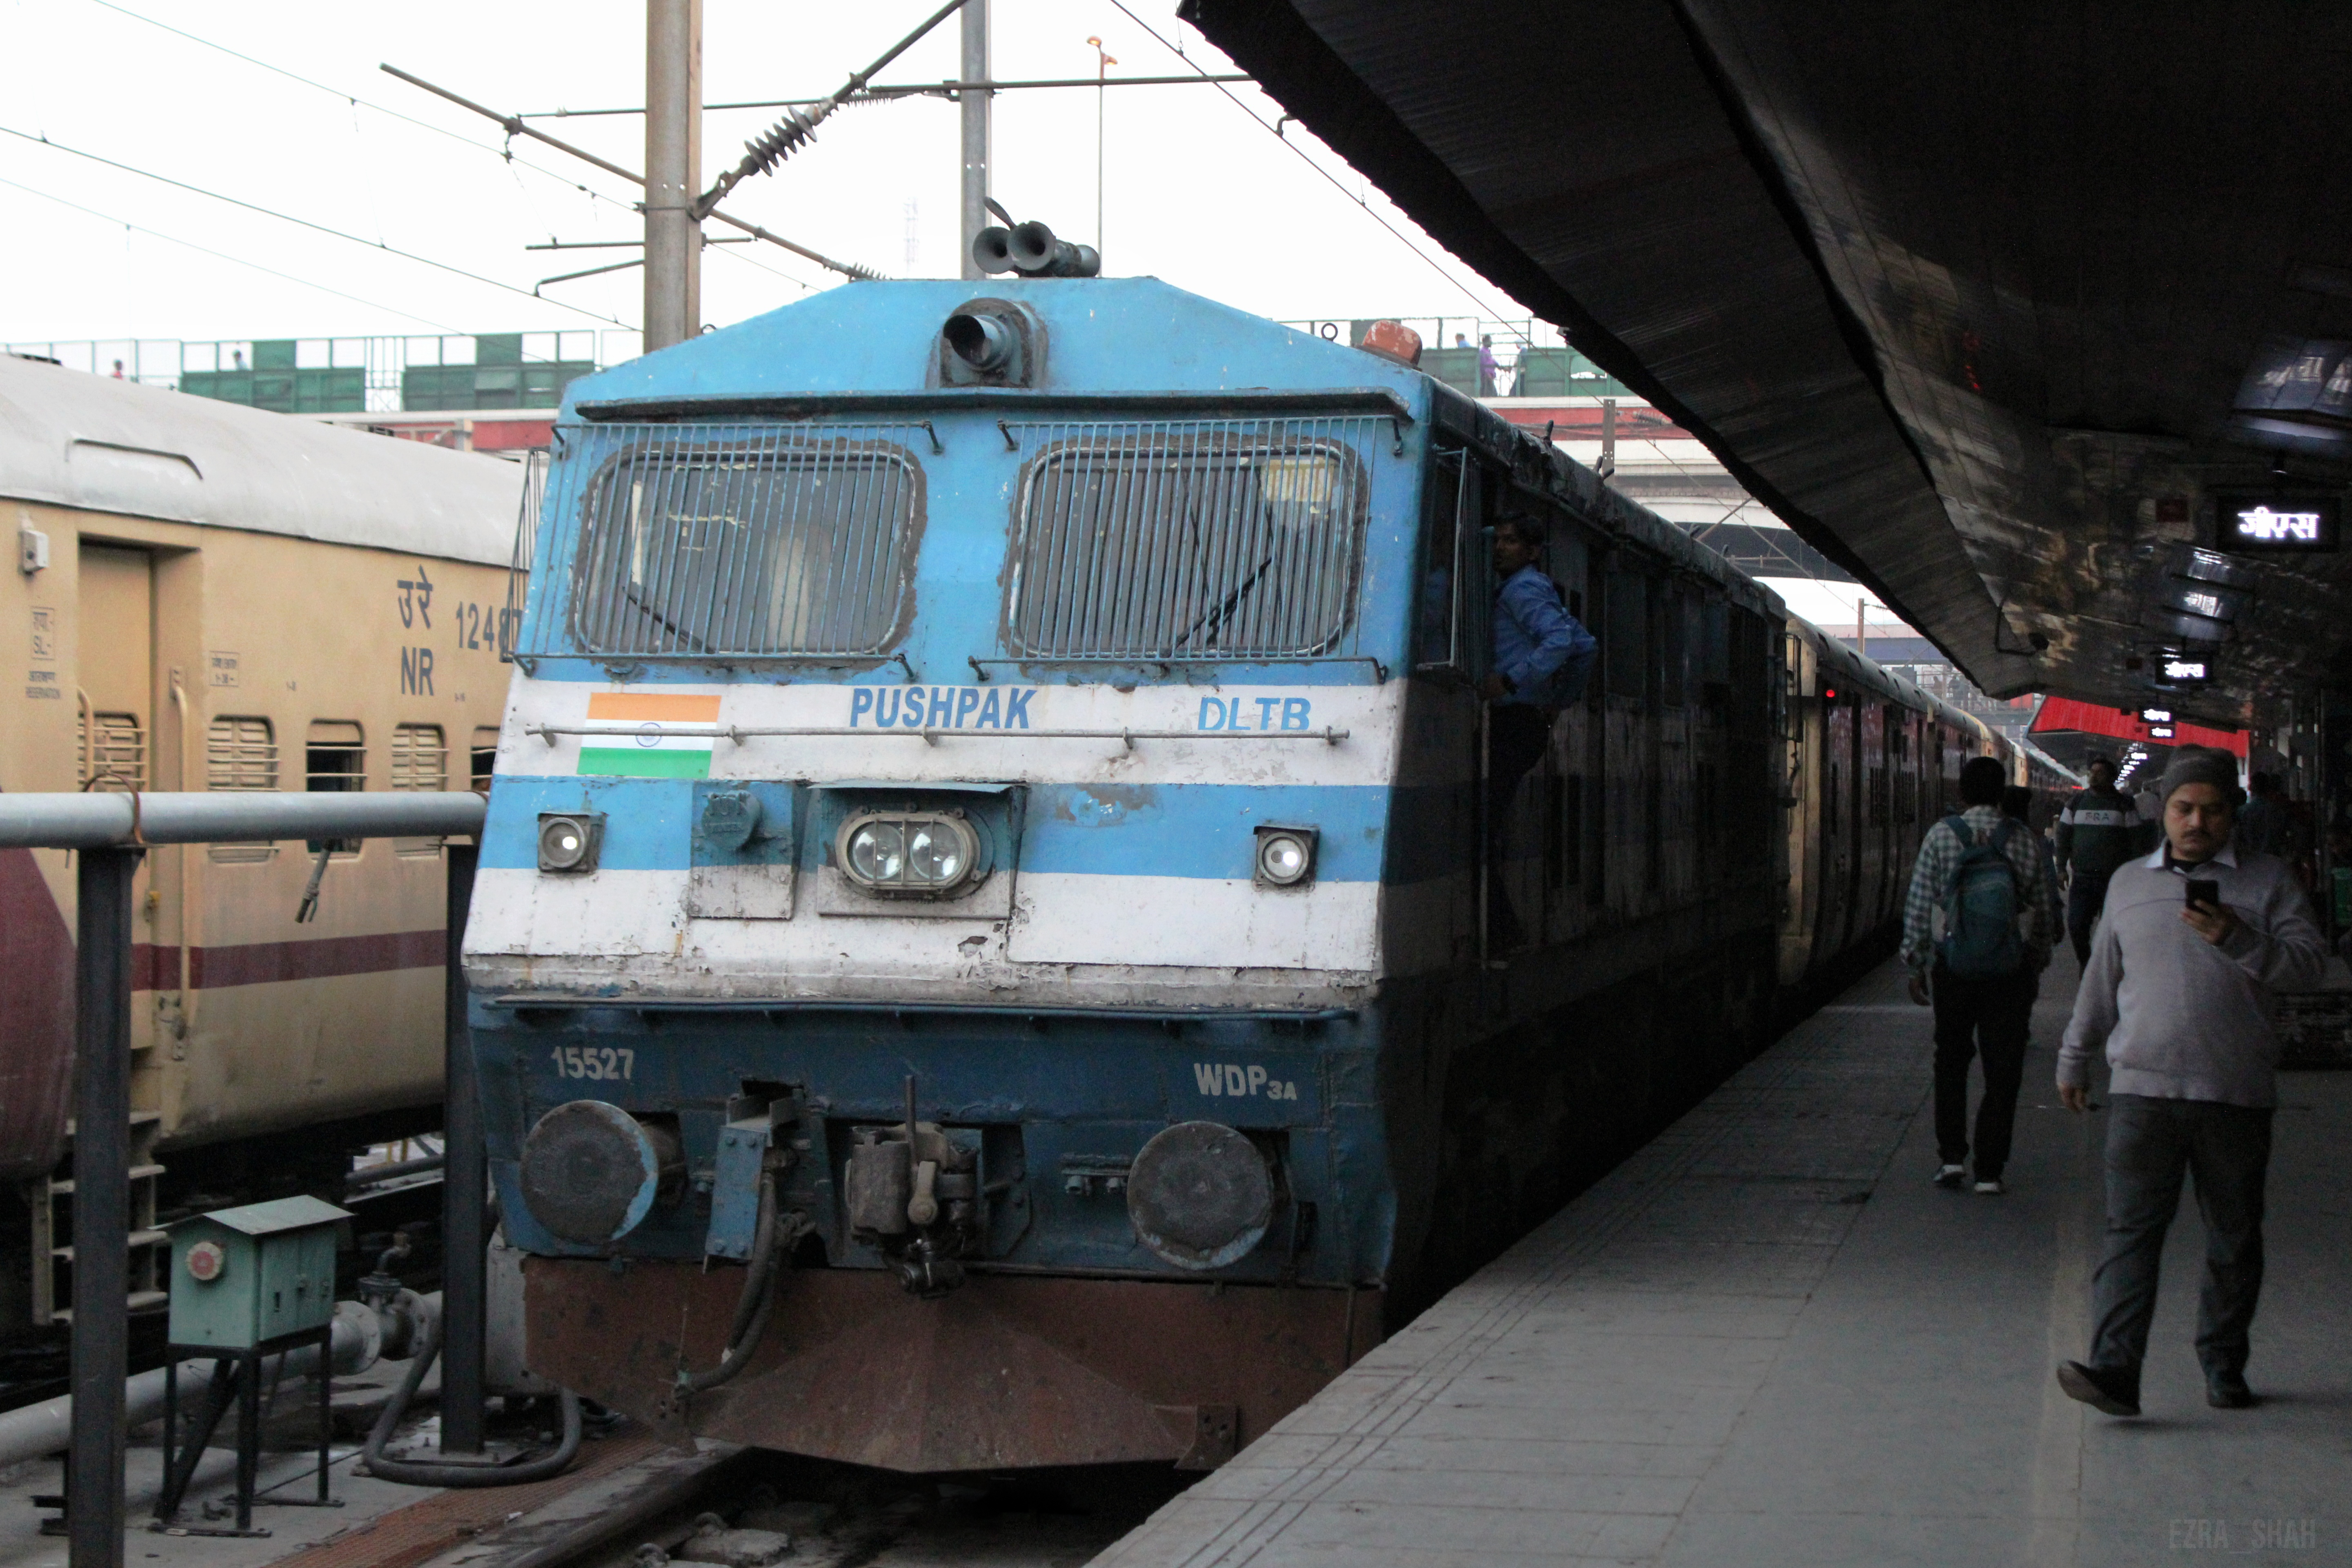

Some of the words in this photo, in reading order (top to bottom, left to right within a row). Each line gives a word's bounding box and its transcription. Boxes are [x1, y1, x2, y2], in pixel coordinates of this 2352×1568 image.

[397, 564, 433, 629] उरे
[401, 646, 434, 696] NR
[850, 686, 1037, 729] PUSHPAK
[1198, 696, 1311, 730] DLTB
[551, 1046, 634, 1080] 15527
